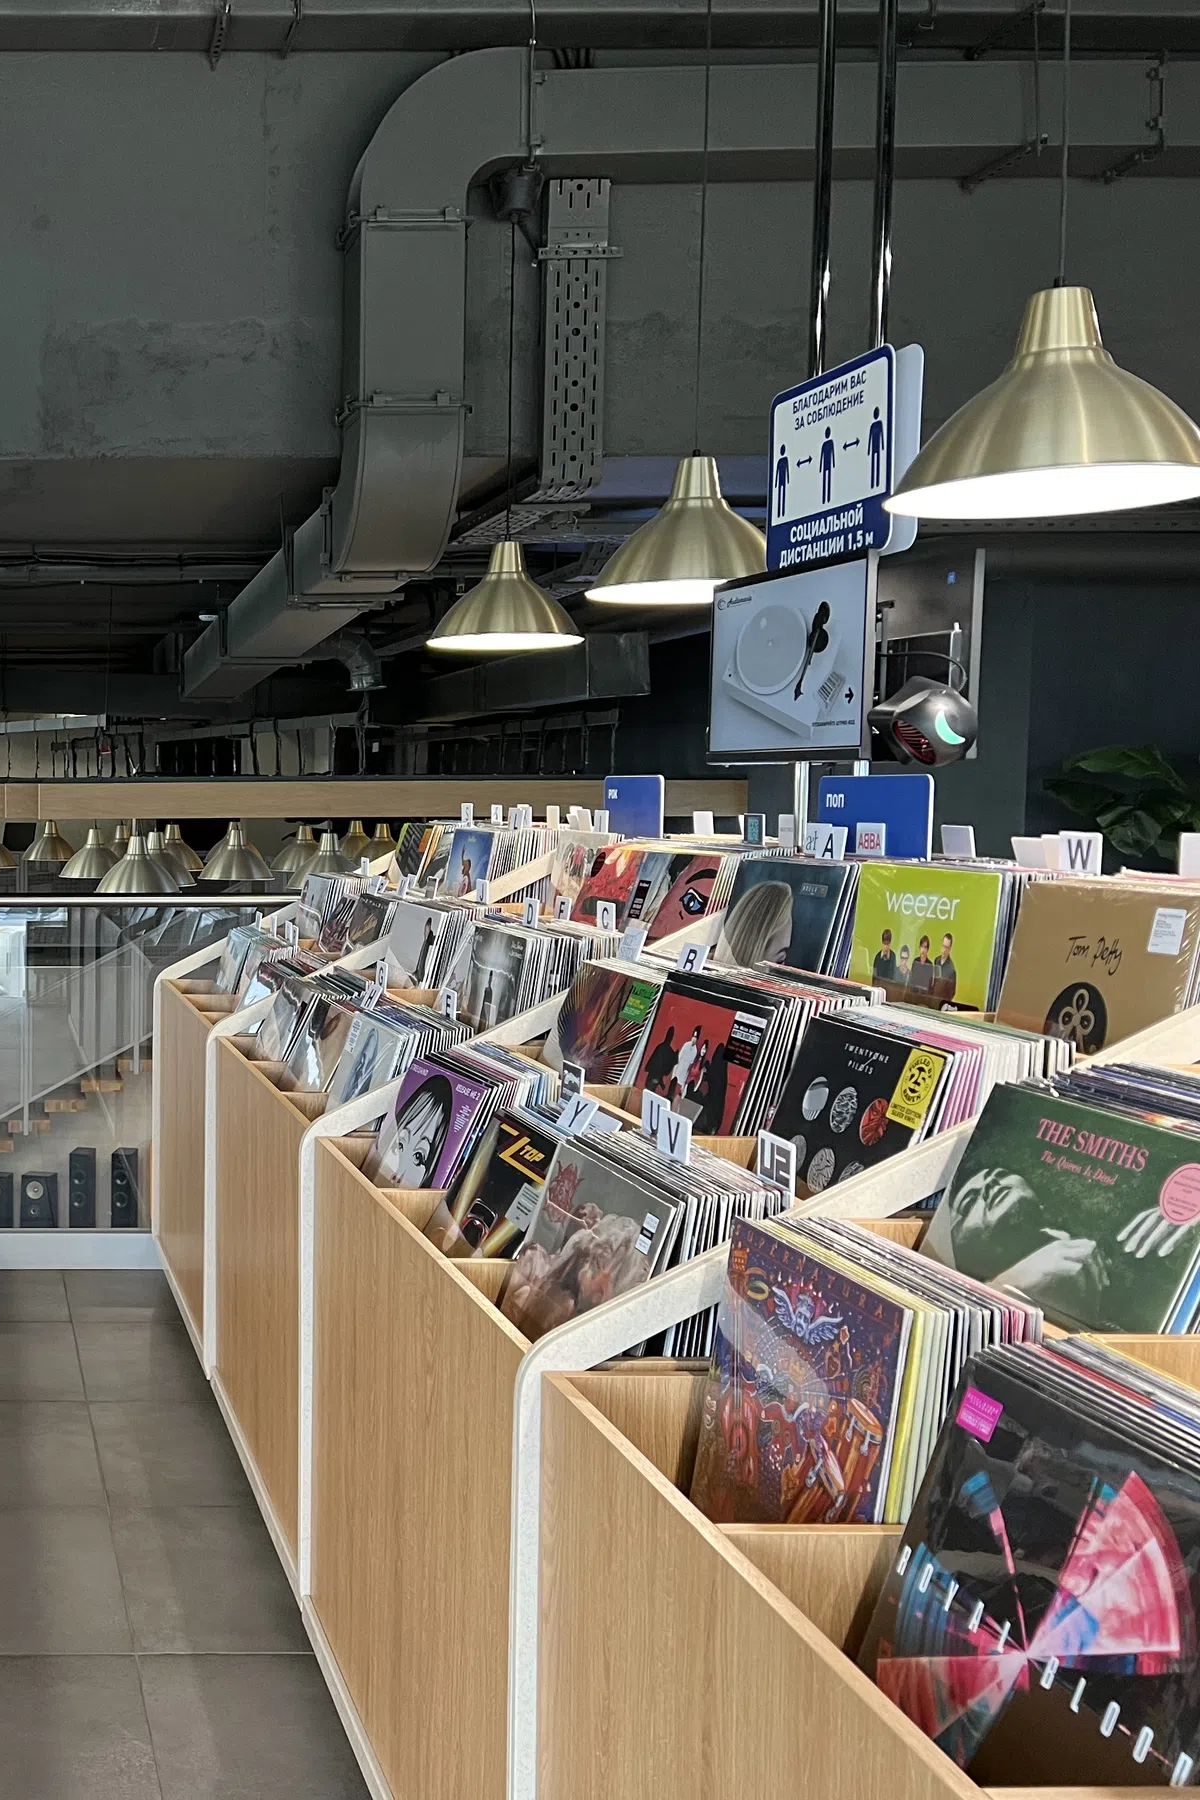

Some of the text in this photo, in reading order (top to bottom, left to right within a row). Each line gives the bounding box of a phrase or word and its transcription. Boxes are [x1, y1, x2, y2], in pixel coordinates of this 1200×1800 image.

[792, 370, 867, 415] БЛАГОДАРИМ ВАС
[794, 390, 864, 430] ЗА СОБЛЮДЕНИЕ
[790, 503, 864, 543] СОЦИАЛЬНОЙ
[780, 537, 845, 569] ДИСТАНЦИИ
[826, 793, 845, 808] ПОП
[822, 833, 835, 859] A
[858, 832, 881, 850] ABBA
[1067, 838, 1093, 870] W
[527, 905, 534, 925] D
[558, 901, 566, 919] F
[602, 907, 609, 929] C
[886, 891, 960, 920] weezer
[683, 949, 697, 971] B
[1065, 936, 1123, 976] Tom Petty
[378, 967, 384, 986] G
[363, 989, 377, 1008] H
[569, 1100, 589, 1128] Y
[650, 1100, 661, 1134] U
[664, 1117, 681, 1148] V
[1035, 1118, 1149, 1172] THE SMITHS
[520, 1144, 546, 1163] TOP
[1040, 1150, 1118, 1186] The Queen Is Dead
[1040, 1655, 1193, 1787] BLOOD
